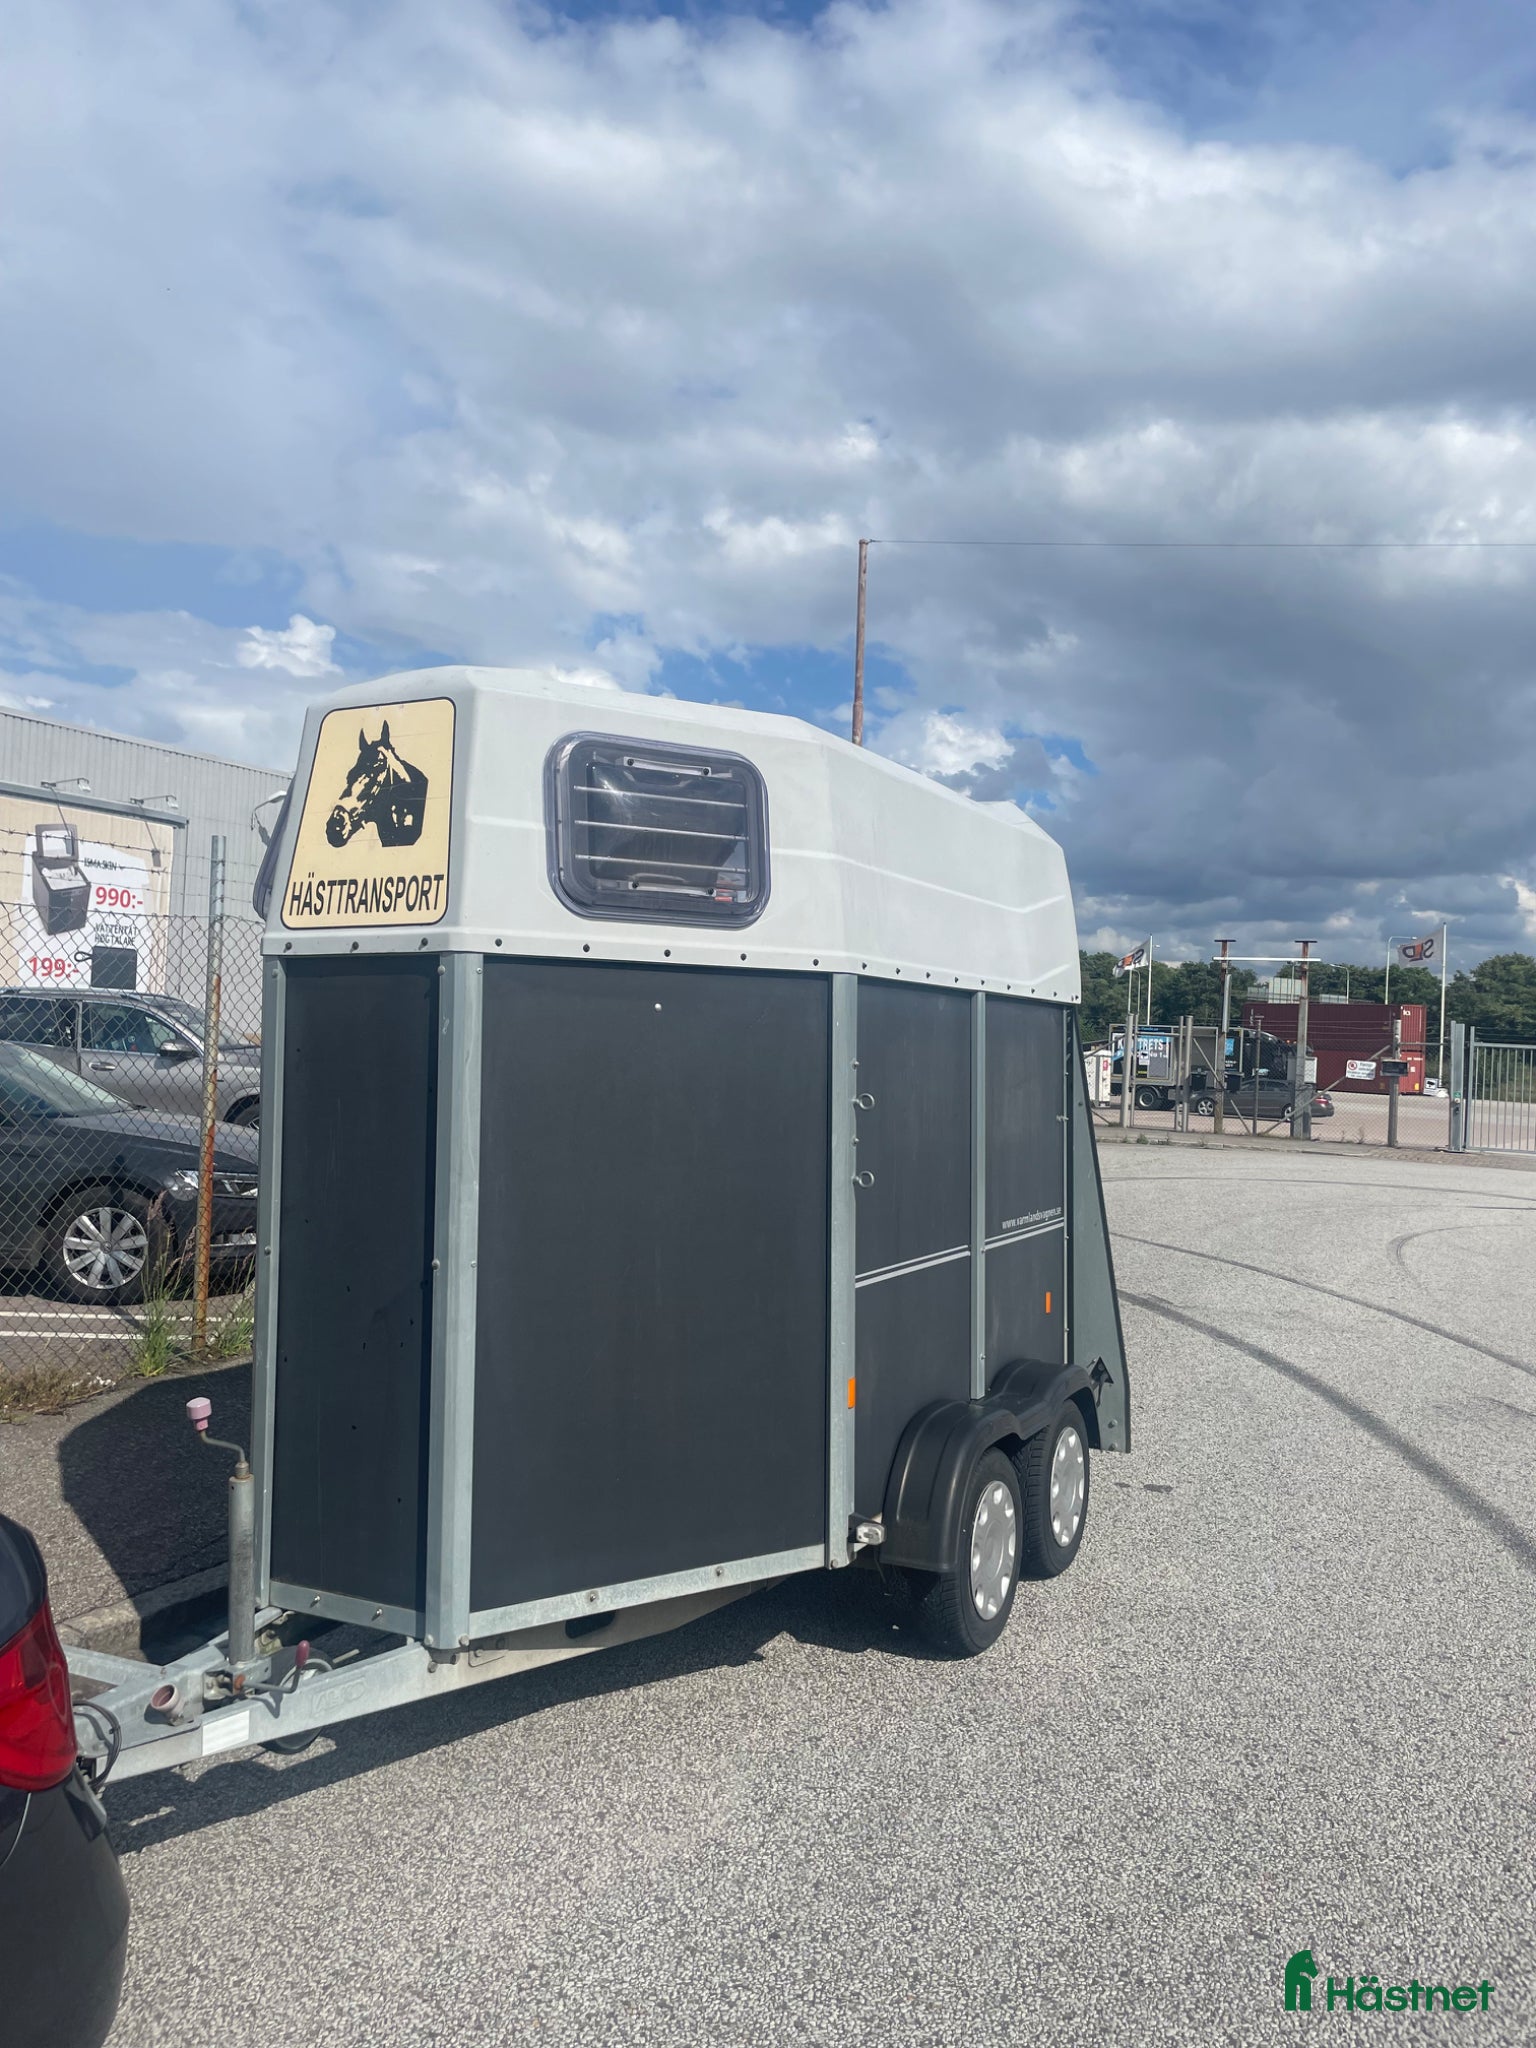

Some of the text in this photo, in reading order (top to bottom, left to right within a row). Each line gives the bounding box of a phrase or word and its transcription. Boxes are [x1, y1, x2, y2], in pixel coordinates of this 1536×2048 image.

[95, 886, 143, 909] 990:-
[289, 872, 444, 916] HÄSTTRANSPORT
[29, 955, 79, 979] 199:-
